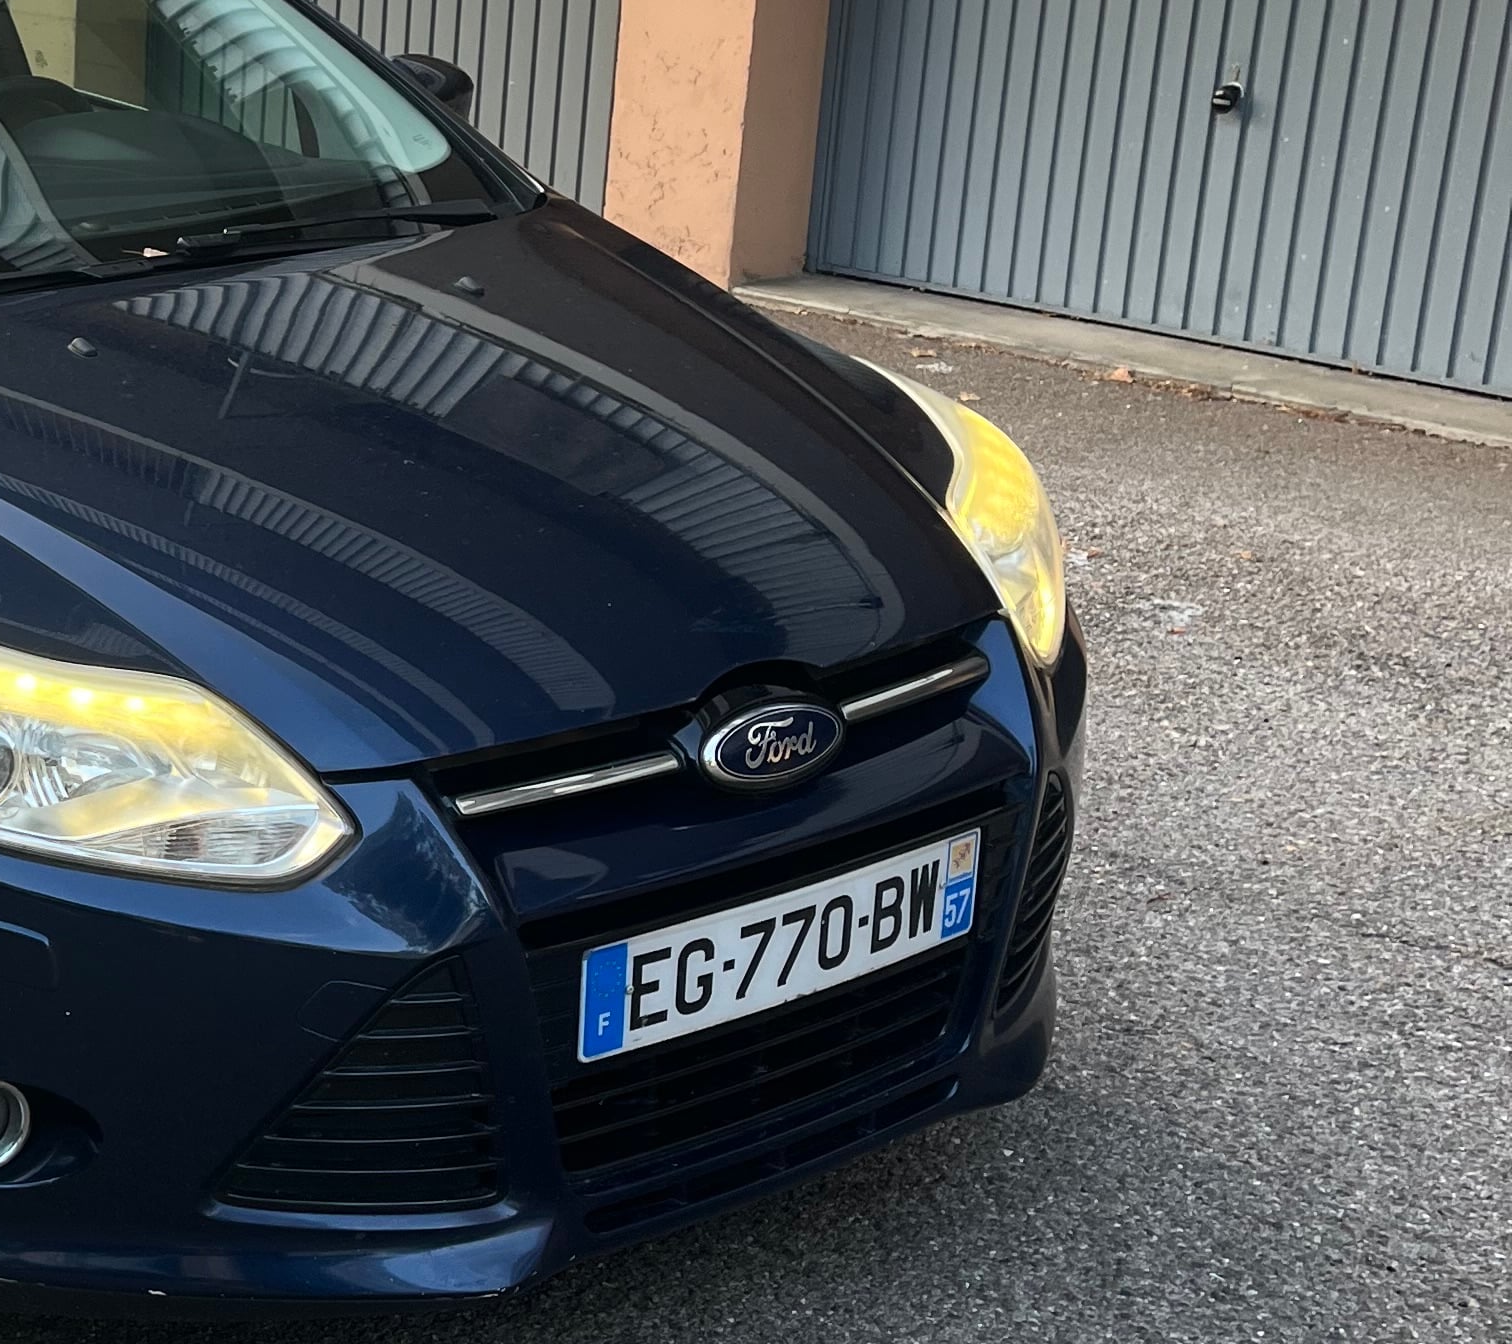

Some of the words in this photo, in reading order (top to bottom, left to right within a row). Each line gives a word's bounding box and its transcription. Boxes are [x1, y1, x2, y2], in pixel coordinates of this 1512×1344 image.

[745, 716, 816, 769] Ford
[944, 887, 971, 928] 57
[629, 859, 941, 1031] EG-770-BW
[597, 1011, 611, 1037] F
